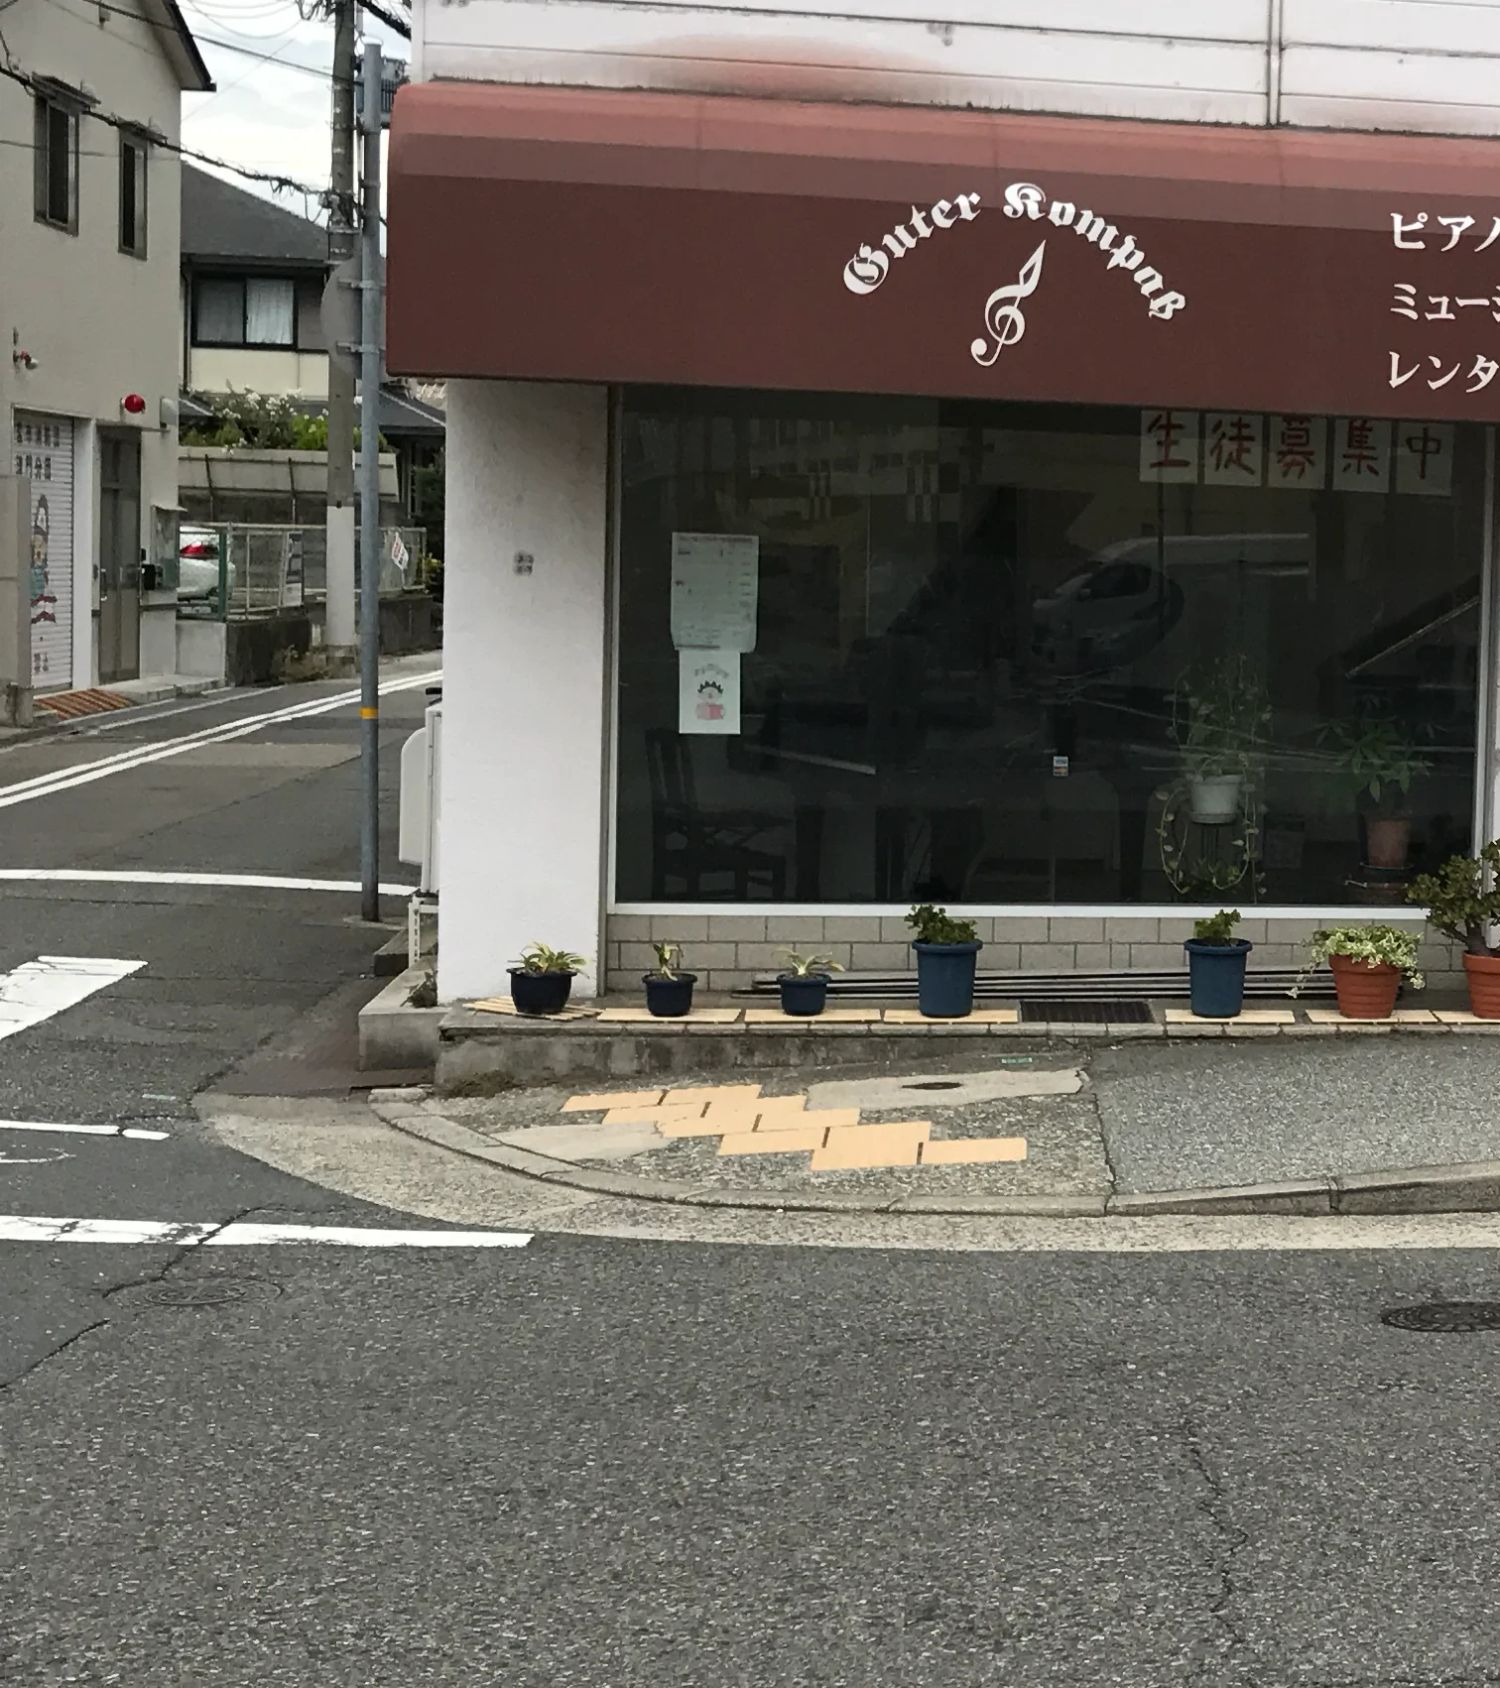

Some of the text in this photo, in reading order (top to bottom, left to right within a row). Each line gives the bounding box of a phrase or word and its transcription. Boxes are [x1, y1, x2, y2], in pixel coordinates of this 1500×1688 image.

[1146, 410, 1441, 480] 生徒募集中
